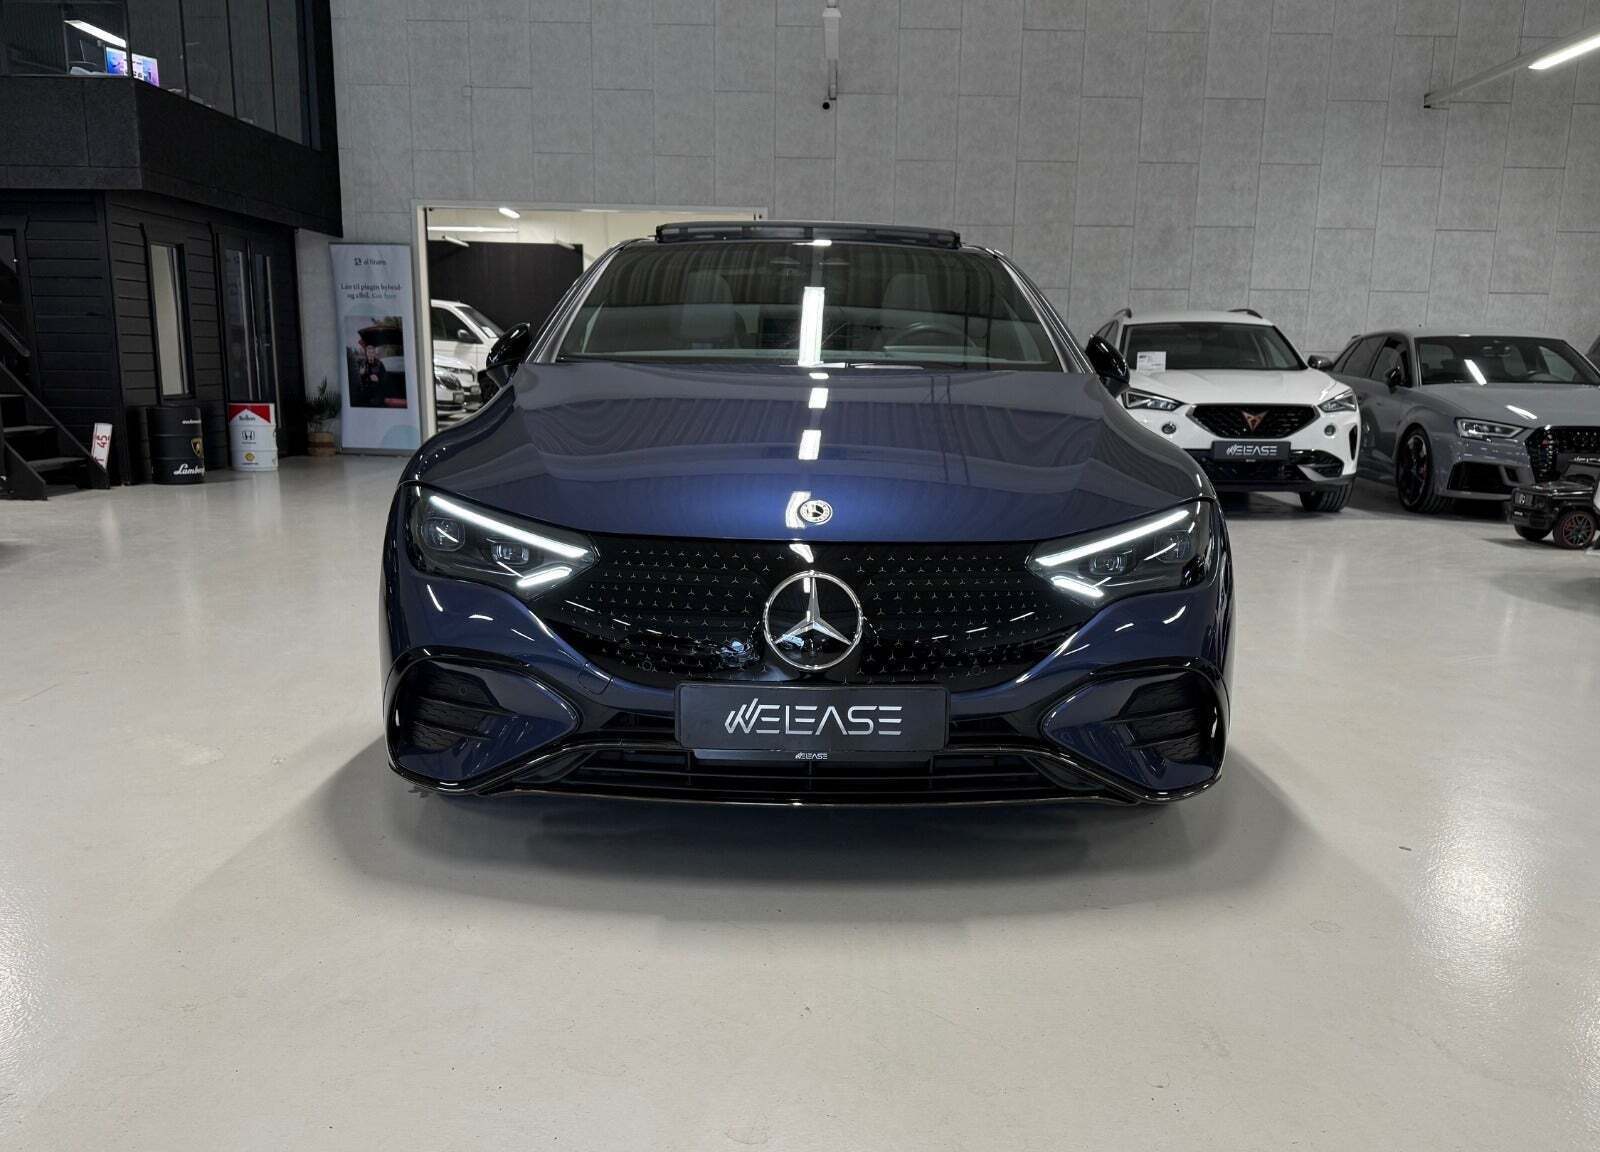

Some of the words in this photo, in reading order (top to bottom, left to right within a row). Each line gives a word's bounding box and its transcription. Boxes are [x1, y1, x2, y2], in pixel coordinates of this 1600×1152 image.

[1225, 443, 1278, 456] WELEASE
[724, 697, 902, 736] WELEASE
[794, 752, 828, 760] WELEASE
